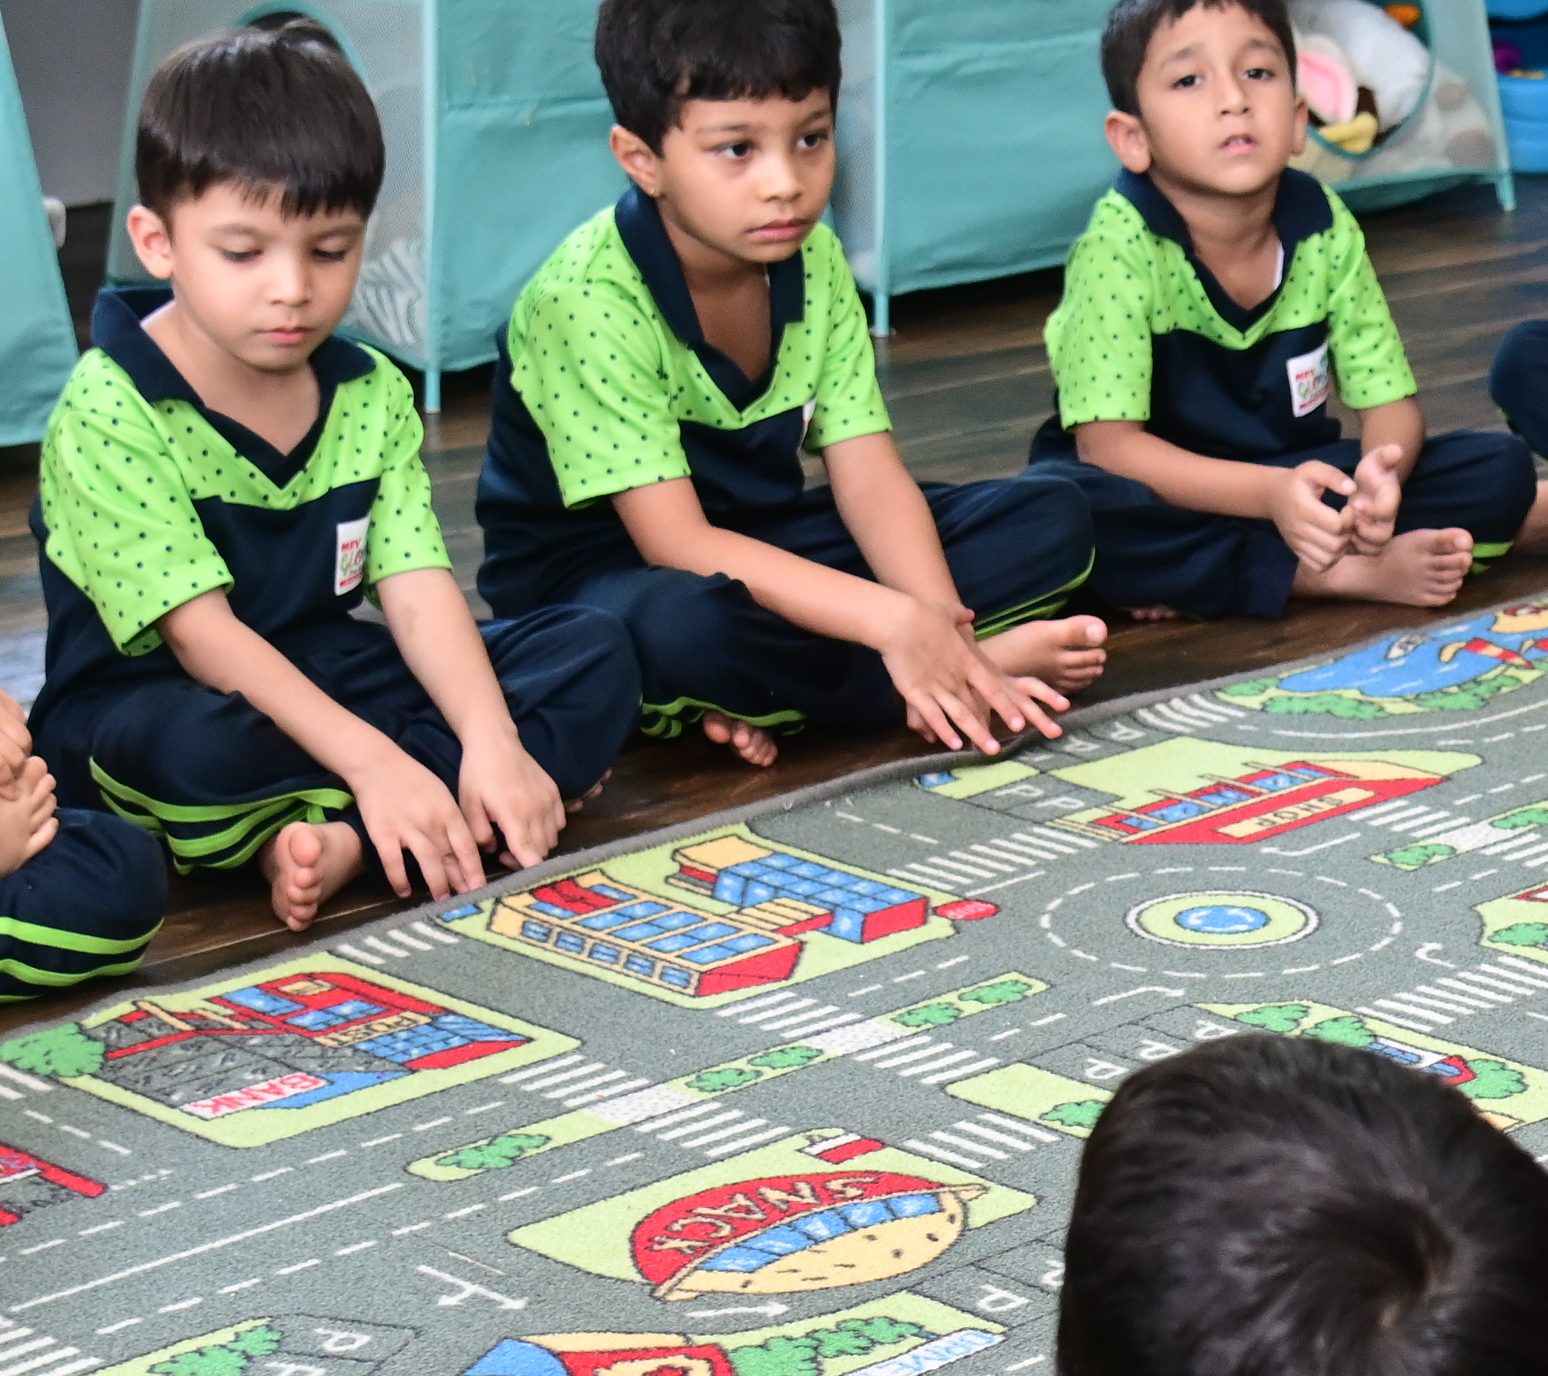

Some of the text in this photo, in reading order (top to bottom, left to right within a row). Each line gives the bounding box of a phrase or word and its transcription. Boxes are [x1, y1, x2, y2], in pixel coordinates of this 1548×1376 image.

[1109, 721, 1146, 742] P
[994, 784, 1045, 798] P
[1036, 795, 1085, 810] P
[322, 1013, 420, 1046] POST
[1195, 1019, 1240, 1040] P
[1138, 1039, 1183, 1060] P
[1083, 1057, 1130, 1081] P
[192, 1072, 321, 1117] BANK
[647, 1175, 882, 1256] SNACK
[975, 1284, 1030, 1313] P
[313, 1327, 372, 1353] P
